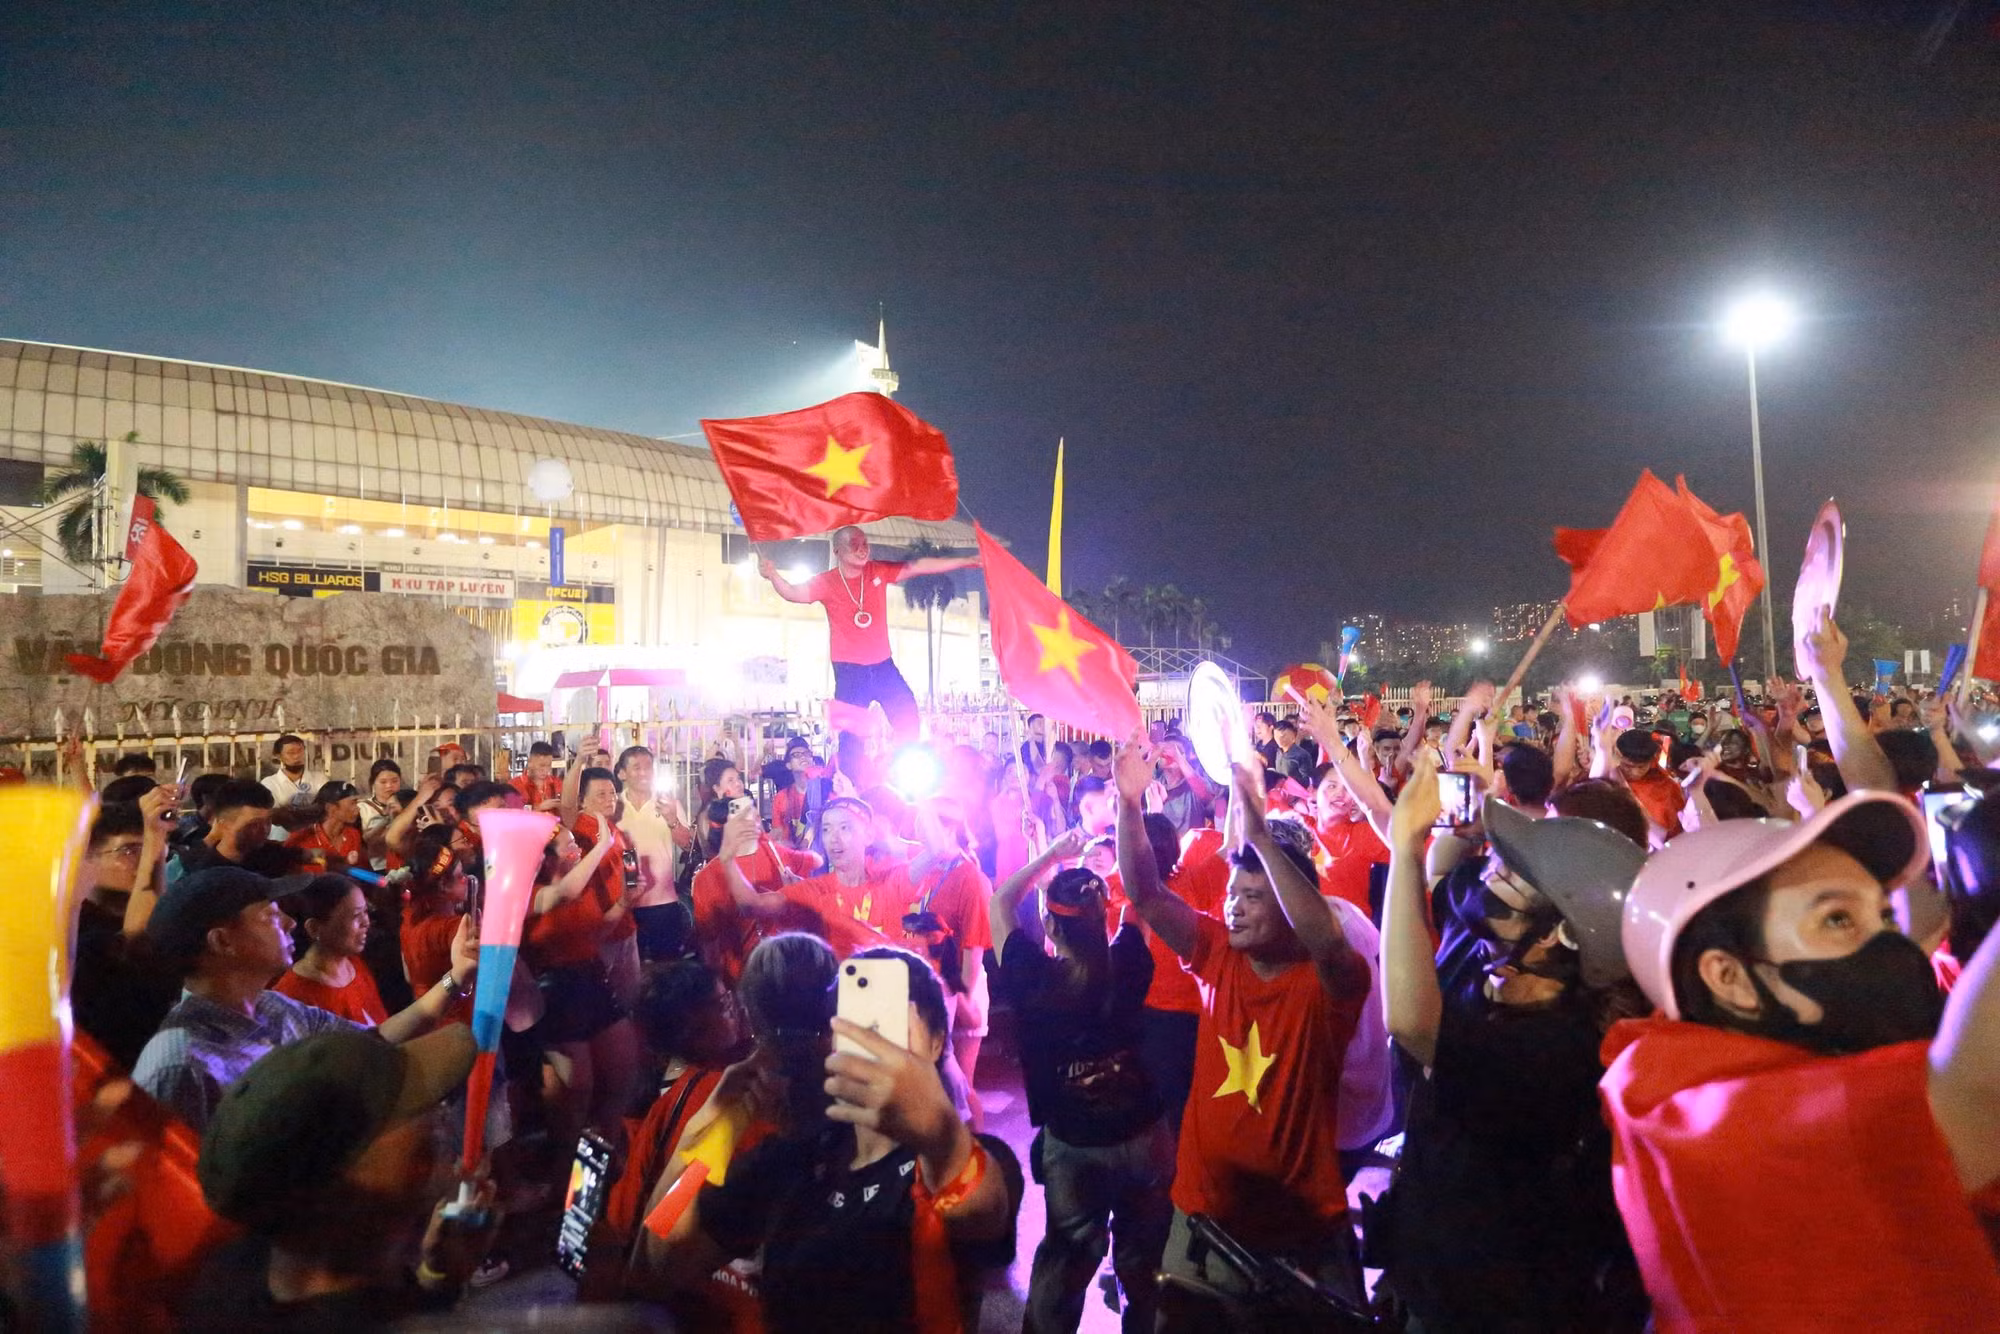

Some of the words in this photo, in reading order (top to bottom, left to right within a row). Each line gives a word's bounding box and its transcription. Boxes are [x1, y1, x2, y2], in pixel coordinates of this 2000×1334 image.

[258, 571, 289, 584] HSG
[294, 572, 362, 587] BILLIARDS
[382, 645, 441, 676] GIA
